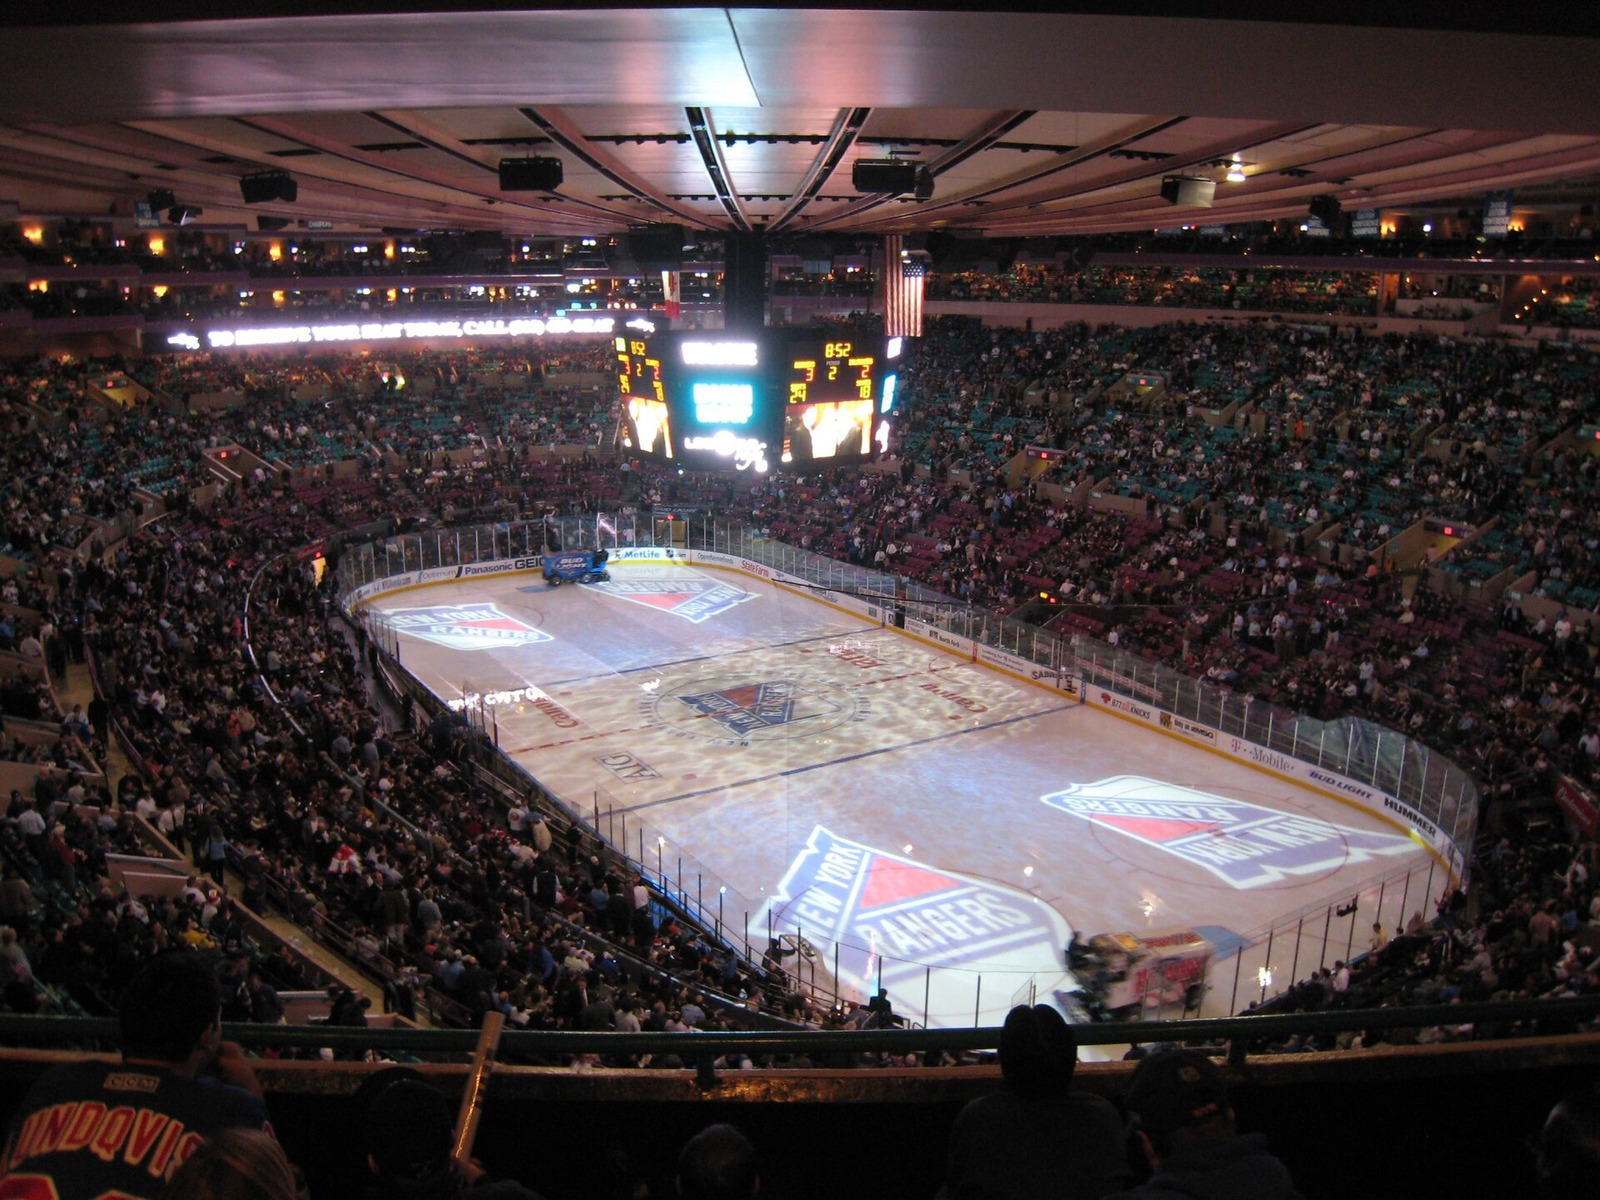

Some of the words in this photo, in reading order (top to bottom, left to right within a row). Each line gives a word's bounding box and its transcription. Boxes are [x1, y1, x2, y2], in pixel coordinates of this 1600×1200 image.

[463, 320, 508, 335] CALL
[825, 343, 851, 358] 8:52
[636, 363, 642, 377] 2
[806, 368, 814, 382] 3
[828, 366, 838, 380] 2
[861, 365, 870, 378] 2
[790, 390, 806, 403] 24
[859, 385, 871, 398] 18
[624, 551, 660, 559] MetLife
[465, 561, 513, 575] Panasonic
[604, 580, 704, 592] RANGERS
[705, 586, 742, 604] NEW
[434, 610, 501, 621] YORK
[430, 625, 540, 640] RANGERS
[725, 709, 768, 729] NEW
[601, 754, 656, 779] AIG
[1309, 770, 1336, 785] BUD
[1337, 779, 1374, 800] LIGHT
[1065, 797, 1240, 822] RANGERS
[1384, 797, 1437, 838] HUMMER
[1246, 818, 1341, 848] NEW
[1176, 835, 1281, 865] YORK
[784, 900, 842, 949] NEW
[814, 842, 862, 889] YORK
[853, 891, 1032, 956] RANGERS
[109, 1077, 158, 1090] CCM
